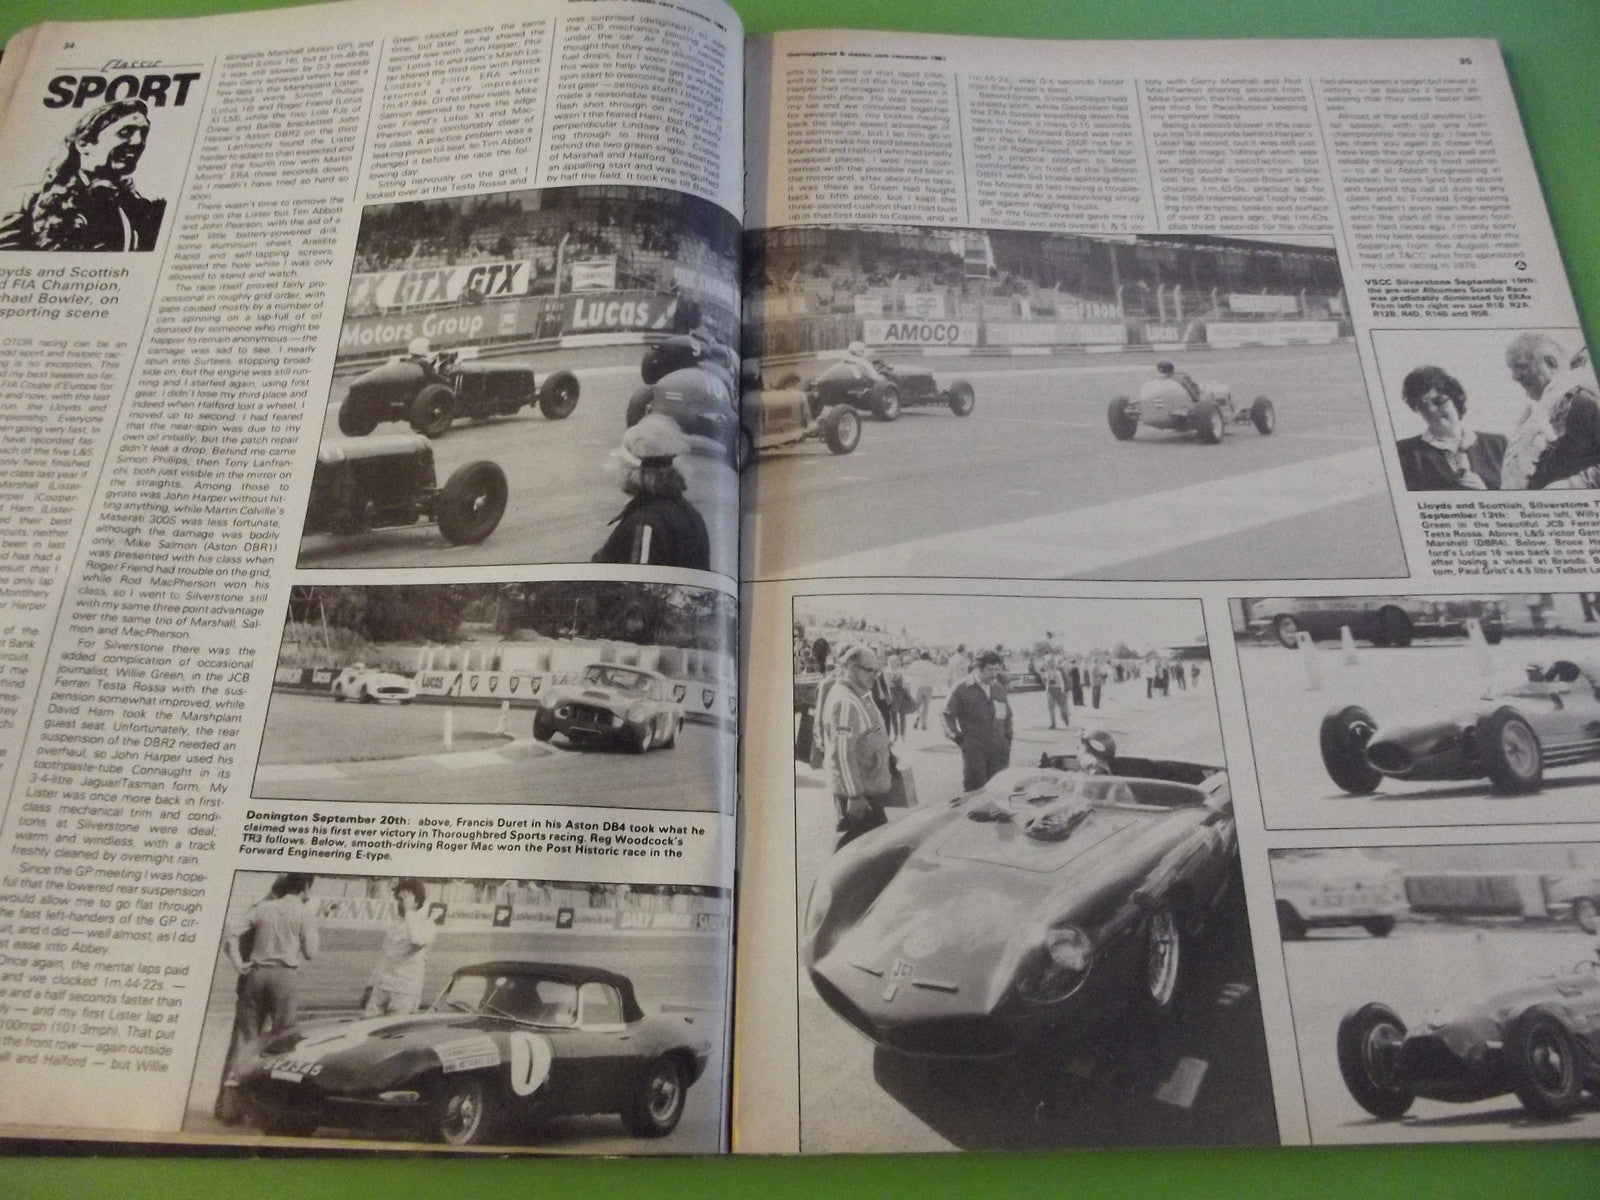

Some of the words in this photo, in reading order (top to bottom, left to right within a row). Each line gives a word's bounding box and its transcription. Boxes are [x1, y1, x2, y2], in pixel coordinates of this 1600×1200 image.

[43, 73, 201, 108] SPORT
[0, 267, 32, 278] oyds
[37, 268, 65, 277] and
[70, 266, 129, 278] Scottish
[467, 263, 523, 295] GTX
[13, 279, 36, 289] FIA
[42, 279, 121, 292] Champion,
[38, 293, 93, 305] Bowler,
[100, 296, 119, 304] on
[0, 307, 60, 320] sporting
[66, 310, 109, 318] scene
[572, 299, 649, 328] Lucas
[342, 322, 413, 346] Motors
[422, 313, 484, 338] Group
[885, 323, 960, 341] AMOCO
[1418, 502, 1452, 510] Lloyds
[1478, 502, 1525, 510] Scottish,
[100, 512, 145, 524] Maserati
[150, 516, 177, 526] 300S
[182, 517, 202, 526] was
[208, 517, 228, 526] less
[232, 518, 281, 528] fortunate,
[61, 652, 96, 662] added
[103, 654, 172, 667] complication
[179, 656, 191, 667] of
[197, 658, 254, 669] occasional
[246, 811, 308, 823] Donington
[312, 813, 376, 824] September
[380, 815, 411, 825] 20th:
[418, 817, 452, 827] above,
[456, 818, 494, 827] Francis
[497, 818, 527, 828] Duret
[531, 819, 541, 828] in
[546, 820, 562, 828] his
[566, 820, 599, 830] Aston
[603, 821, 626, 831] DB4
[629, 824, 655, 833] took
[659, 825, 687, 834] what
[691, 826, 705, 835] he
[244, 823, 285, 832] claimed
[312, 826, 327, 835] his
[330, 826, 351, 835] first
[380, 827, 416, 839] victory
[419, 829, 428, 837] in
[432, 829, 506, 841] Thoroughbred
[510, 830, 546, 841] Sports
[549, 833, 587, 843] racing.
[590, 833, 612, 844] Reg
[239, 845, 283, 855] Forward
[288, 847, 351, 860] Engineering
[243, 833, 262, 843] TR3
[311, 837, 347, 847] Below,
[352, 838, 432, 851] smooth-driving
[436, 841, 467, 852] Roger
[471, 842, 494, 850] Mac
[525, 843, 542, 852] the
[546, 844, 571, 853] Post
[576, 846, 619, 855] Historic
[650, 848, 660, 857] in
[664, 849, 683, 858] the
[3, 877, 17, 887] ful
[20, 878, 42, 889] that
[45, 879, 63, 890] the
[66, 881, 113, 893] lowered
[116, 884, 138, 894] rear
[141, 886, 206, 897] suspension
[524, 1038, 534, 1085] 1
